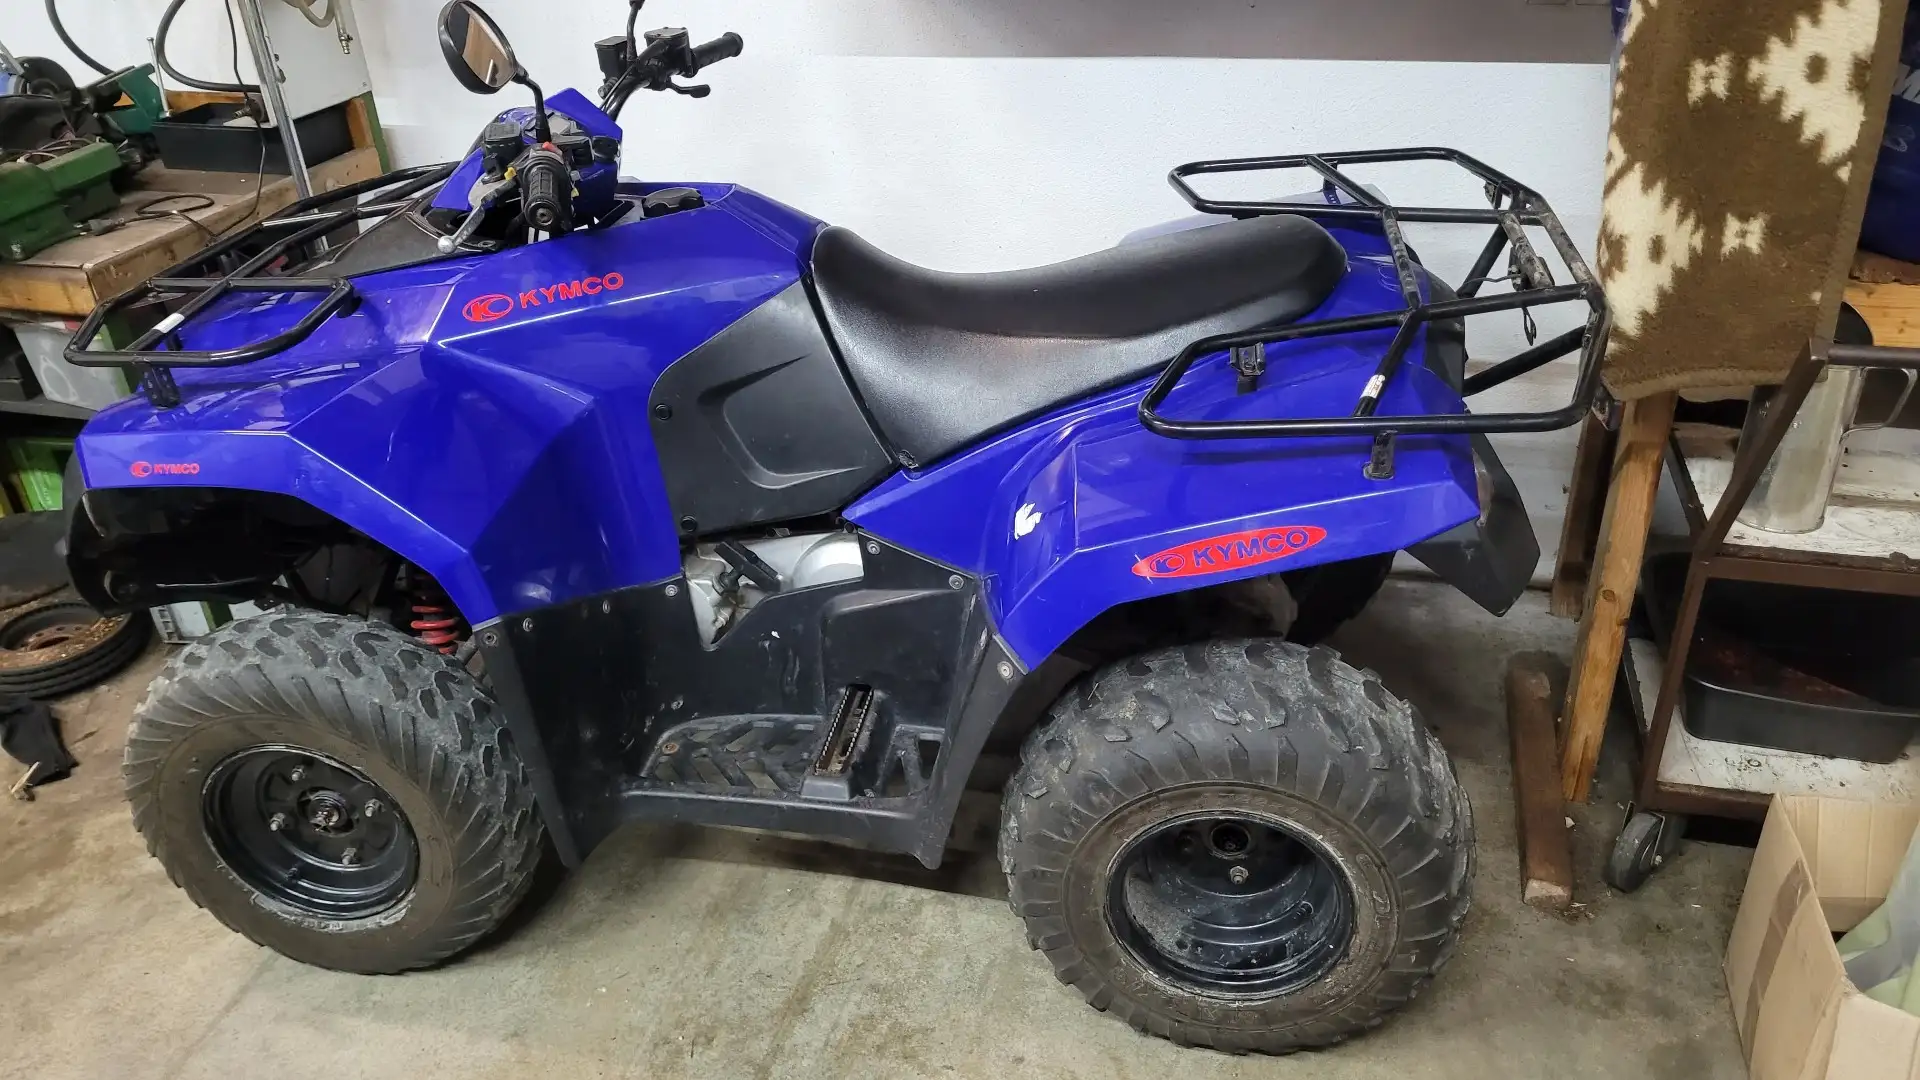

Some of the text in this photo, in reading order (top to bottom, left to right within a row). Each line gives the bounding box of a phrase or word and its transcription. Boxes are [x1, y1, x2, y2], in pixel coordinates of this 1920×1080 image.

[519, 271, 624, 309] KYMCO
[153, 463, 200, 475] KYMCO
[1192, 529, 1310, 568] KYMCO
